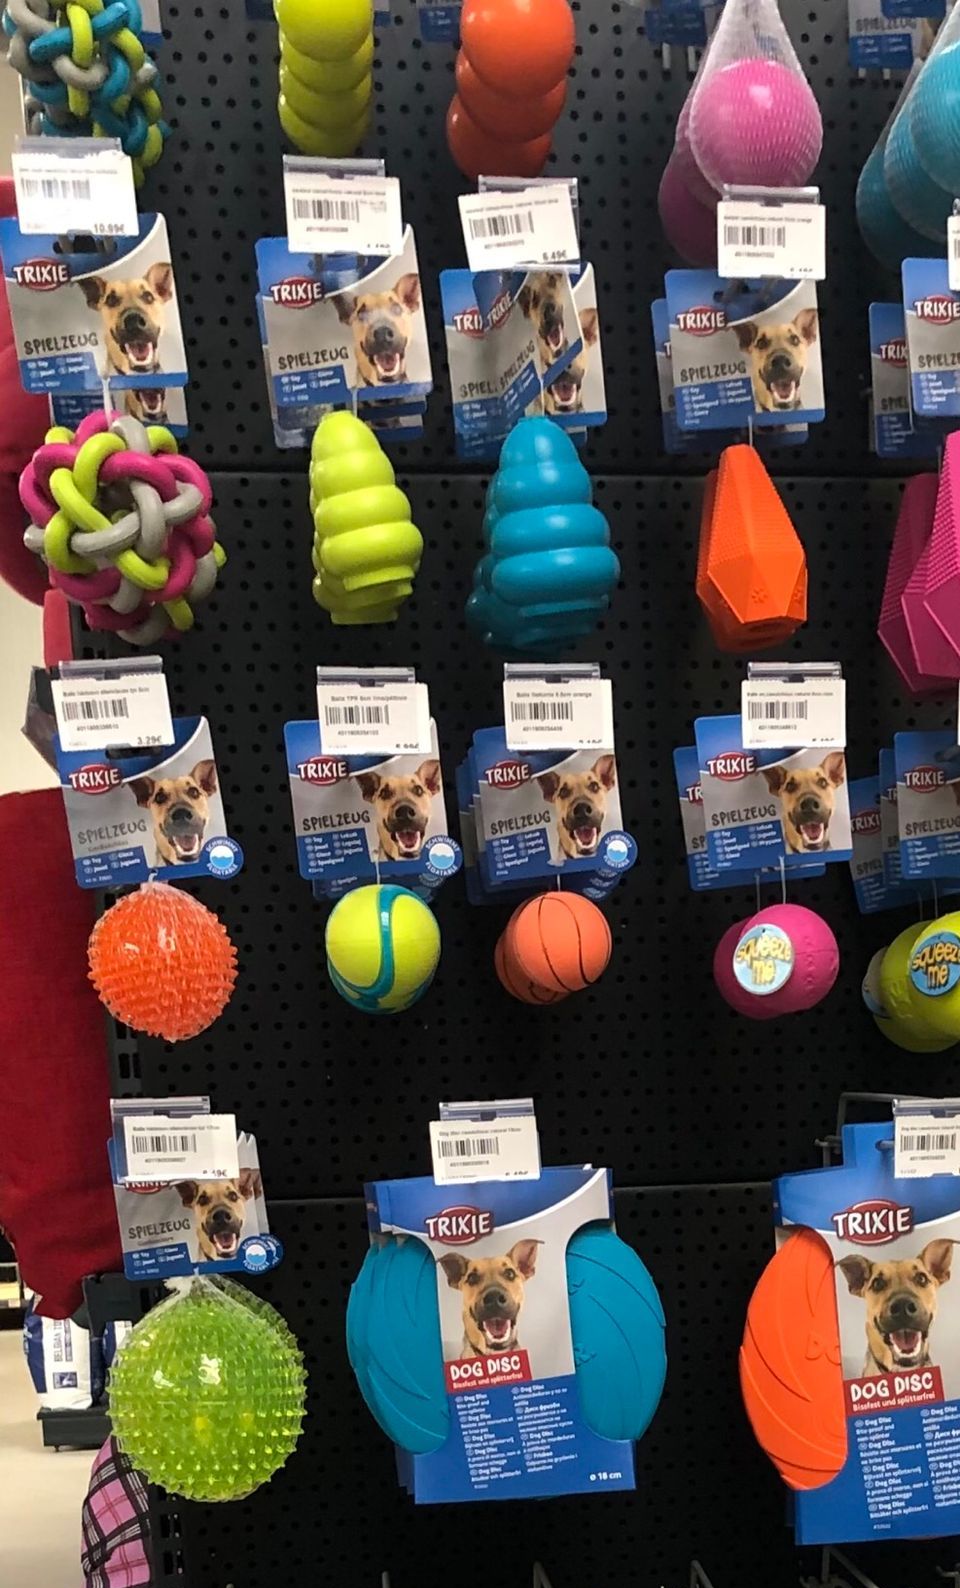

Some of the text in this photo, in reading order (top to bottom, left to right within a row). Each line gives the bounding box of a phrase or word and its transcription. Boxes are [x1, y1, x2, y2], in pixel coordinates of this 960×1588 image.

[13, 261, 69, 284] TRIXIE
[270, 283, 325, 303] TRIXIE
[914, 299, 960, 319] TRIXIE
[676, 310, 726, 330] TRIXIE
[24, 332, 98, 355] SPIELZEUG
[278, 347, 349, 370] SPIELZEUG
[679, 361, 747, 382] SPIELZEUG
[298, 762, 348, 782] TRIXIE
[486, 766, 530, 783] TRIXIE
[708, 757, 754, 776] TRIXIE
[69, 769, 121, 790] TRIXIE
[905, 770, 945, 787] TRIXIE
[303, 812, 371, 832] SPIELZEUG
[491, 811, 551, 836] SPIELZEUG
[711, 805, 777, 827] SPIELZEUG
[77, 821, 147, 845] SPIELZEUG
[205, 838, 239, 858] SCHWIMMT
[424, 837, 460, 857] SCHWIMMT
[206, 862, 239, 882] FLOATABLE
[425, 861, 459, 880] FLOATABLE
[926, 963, 948, 987] me
[129, 1219, 190, 1241] SPIELZEUG
[426, 1211, 490, 1238] TRIXIE
[833, 1207, 911, 1238] TRIXIE
[450, 1355, 521, 1381] DOG DISC
[478, 1377, 490, 1386] und
[850, 1372, 934, 1401] DOG DISC
[852, 1392, 936, 1413] Bissfest und splitterfrei
[598, 1471, 608, 1481] 18
[609, 1471, 622, 1480] cm
